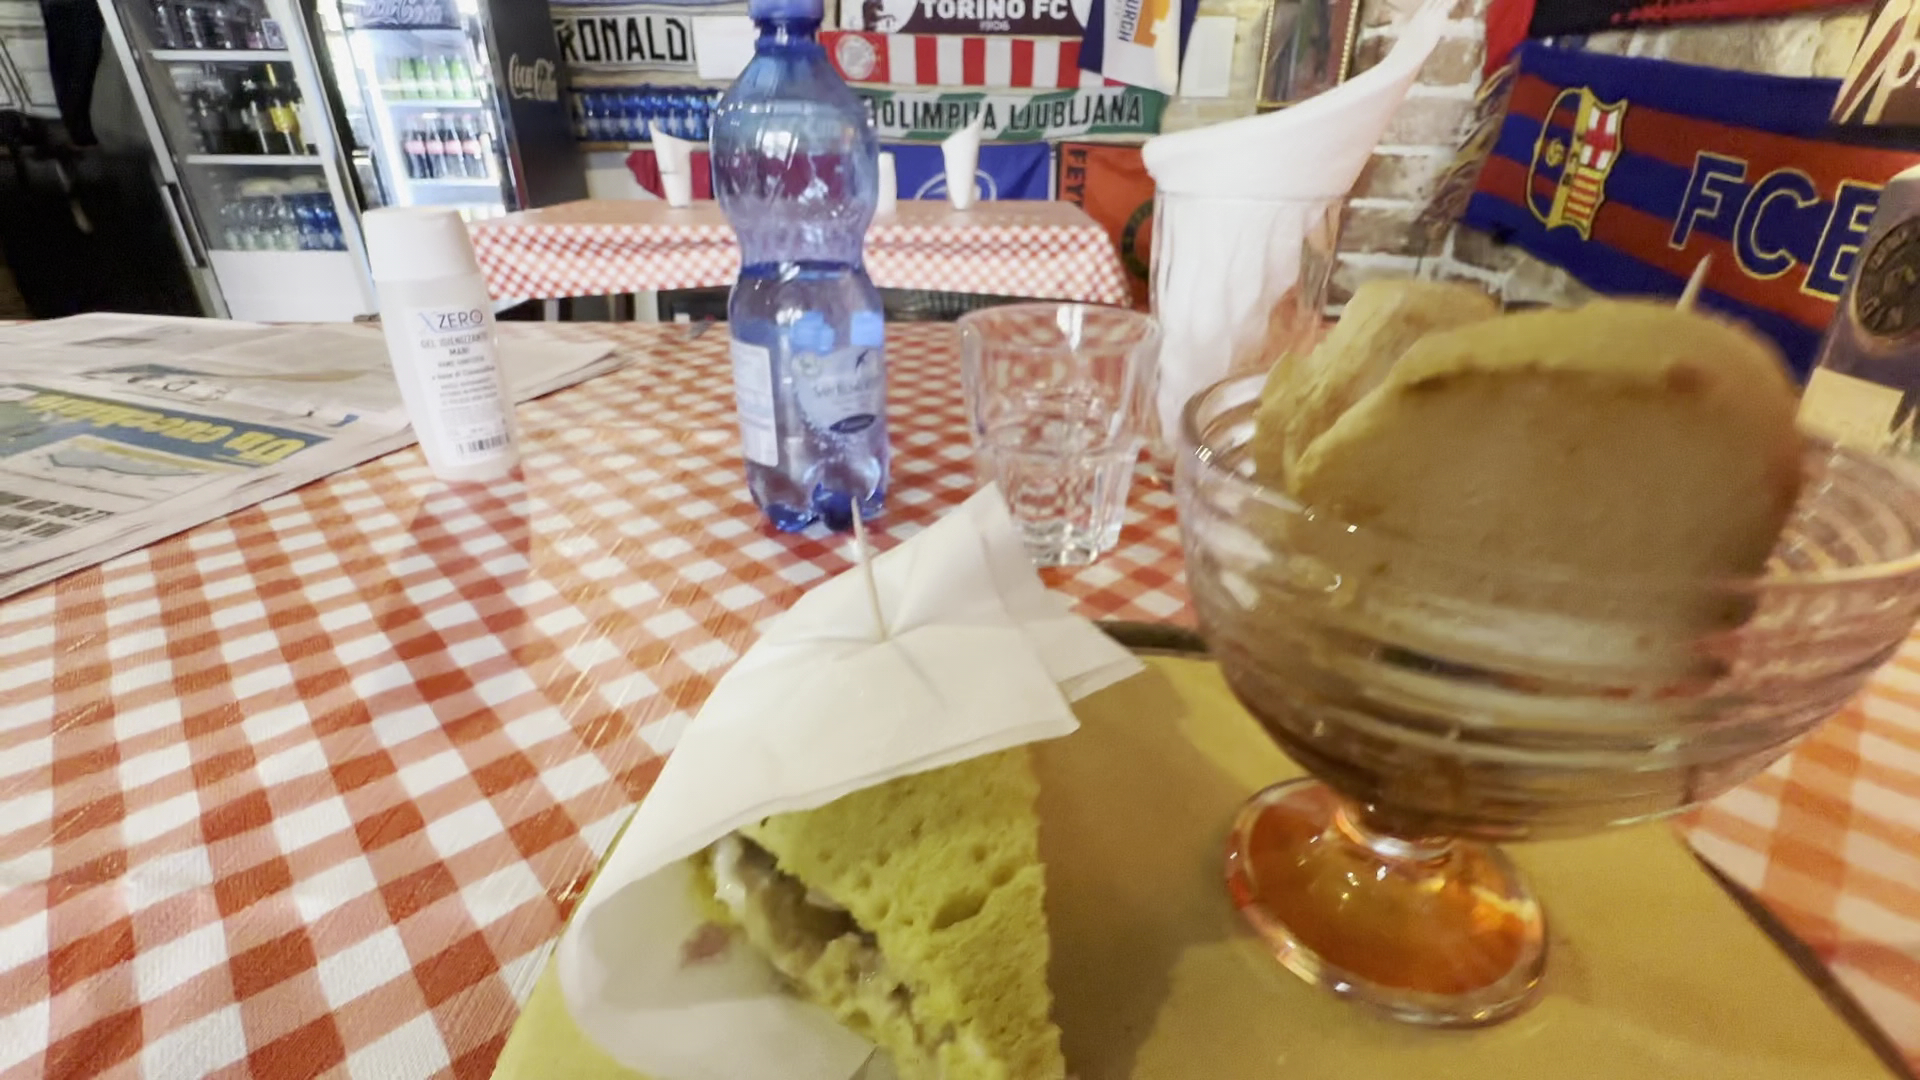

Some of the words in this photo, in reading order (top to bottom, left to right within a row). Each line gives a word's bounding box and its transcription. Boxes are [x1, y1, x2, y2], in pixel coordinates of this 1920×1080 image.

[921, 0, 1026, 20] TORINO
[1032, 0, 1068, 20] FC
[551, 16, 697, 61] RONALD
[1009, 94, 1142, 130] LJUBLJANA
[223, 431, 306, 465] Un
